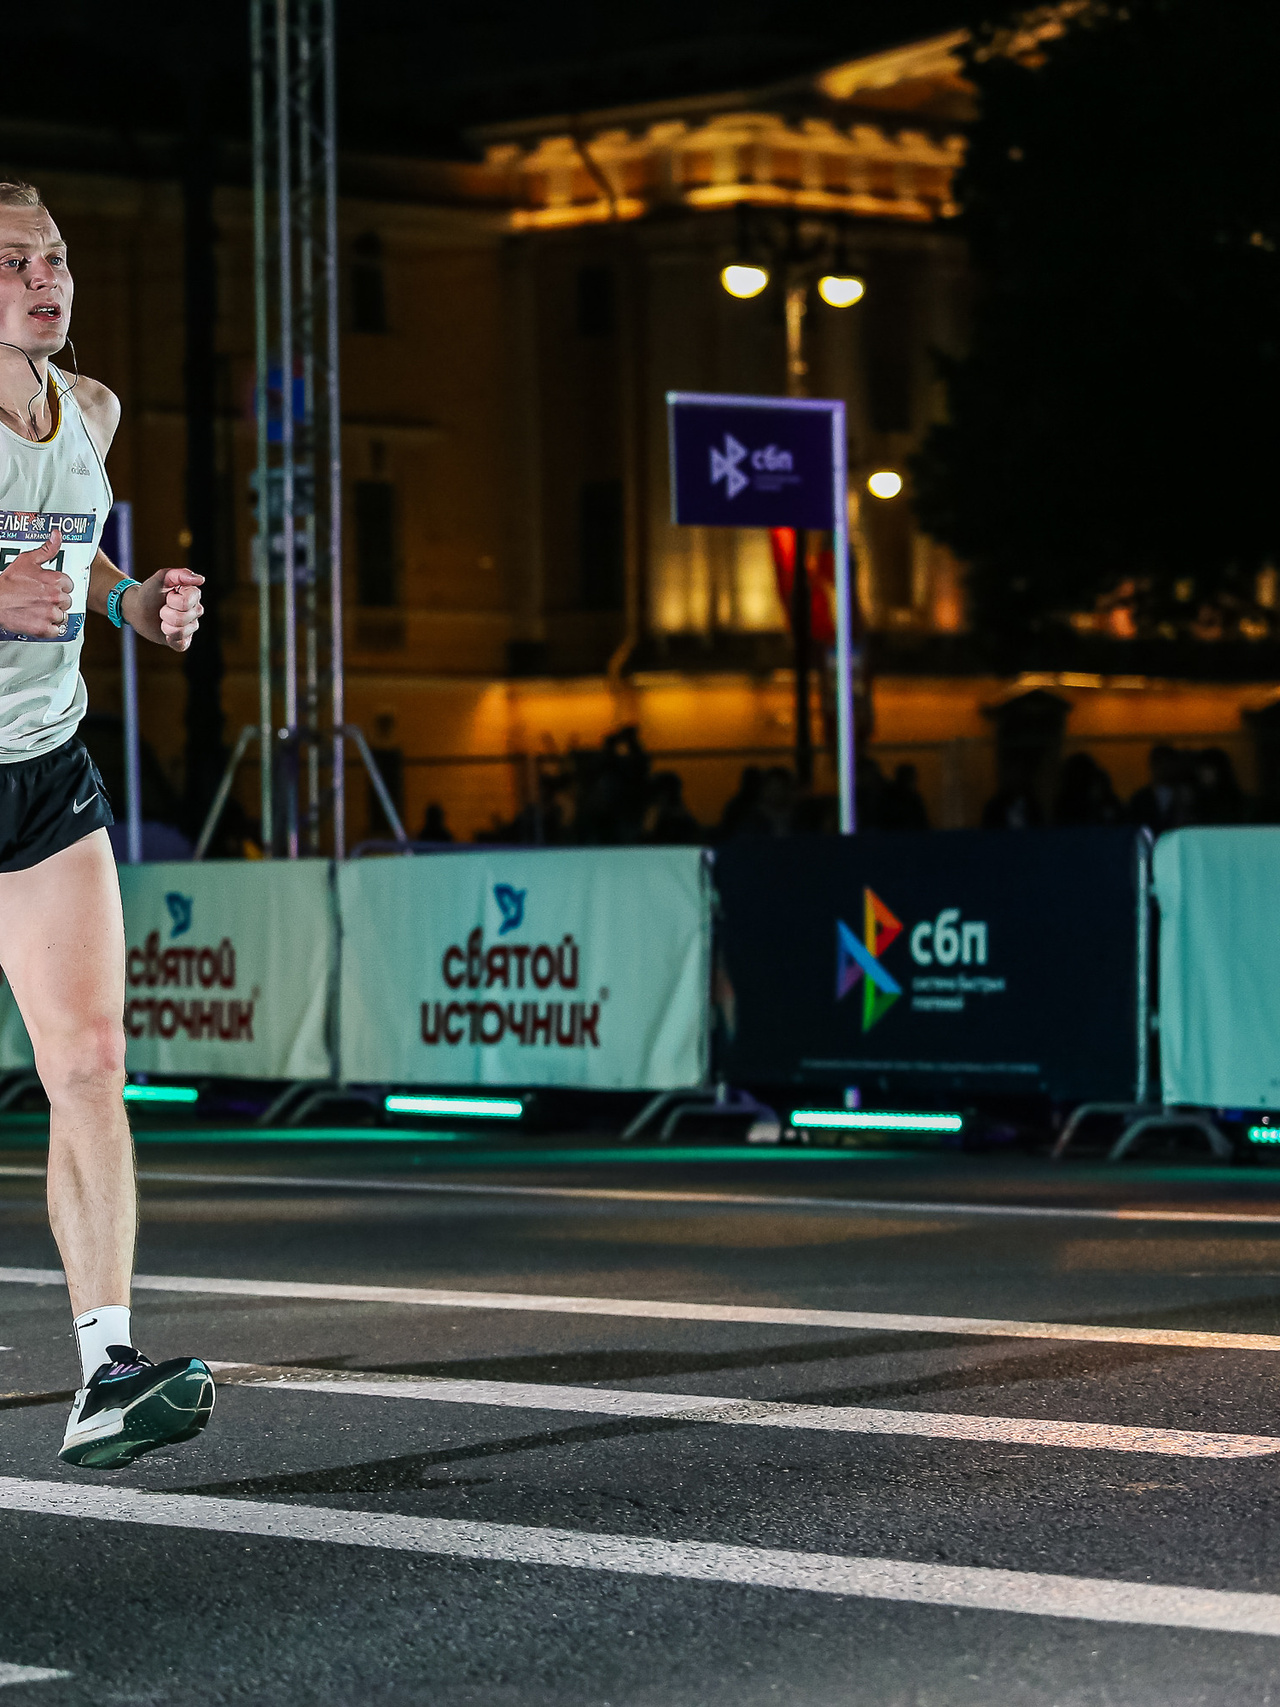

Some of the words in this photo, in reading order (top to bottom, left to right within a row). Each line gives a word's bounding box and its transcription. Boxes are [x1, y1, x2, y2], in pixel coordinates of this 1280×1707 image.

[48, 516, 88, 534] НОЧИ
[910, 908, 988, 967] сбп
[124, 998, 255, 1042] сточник
